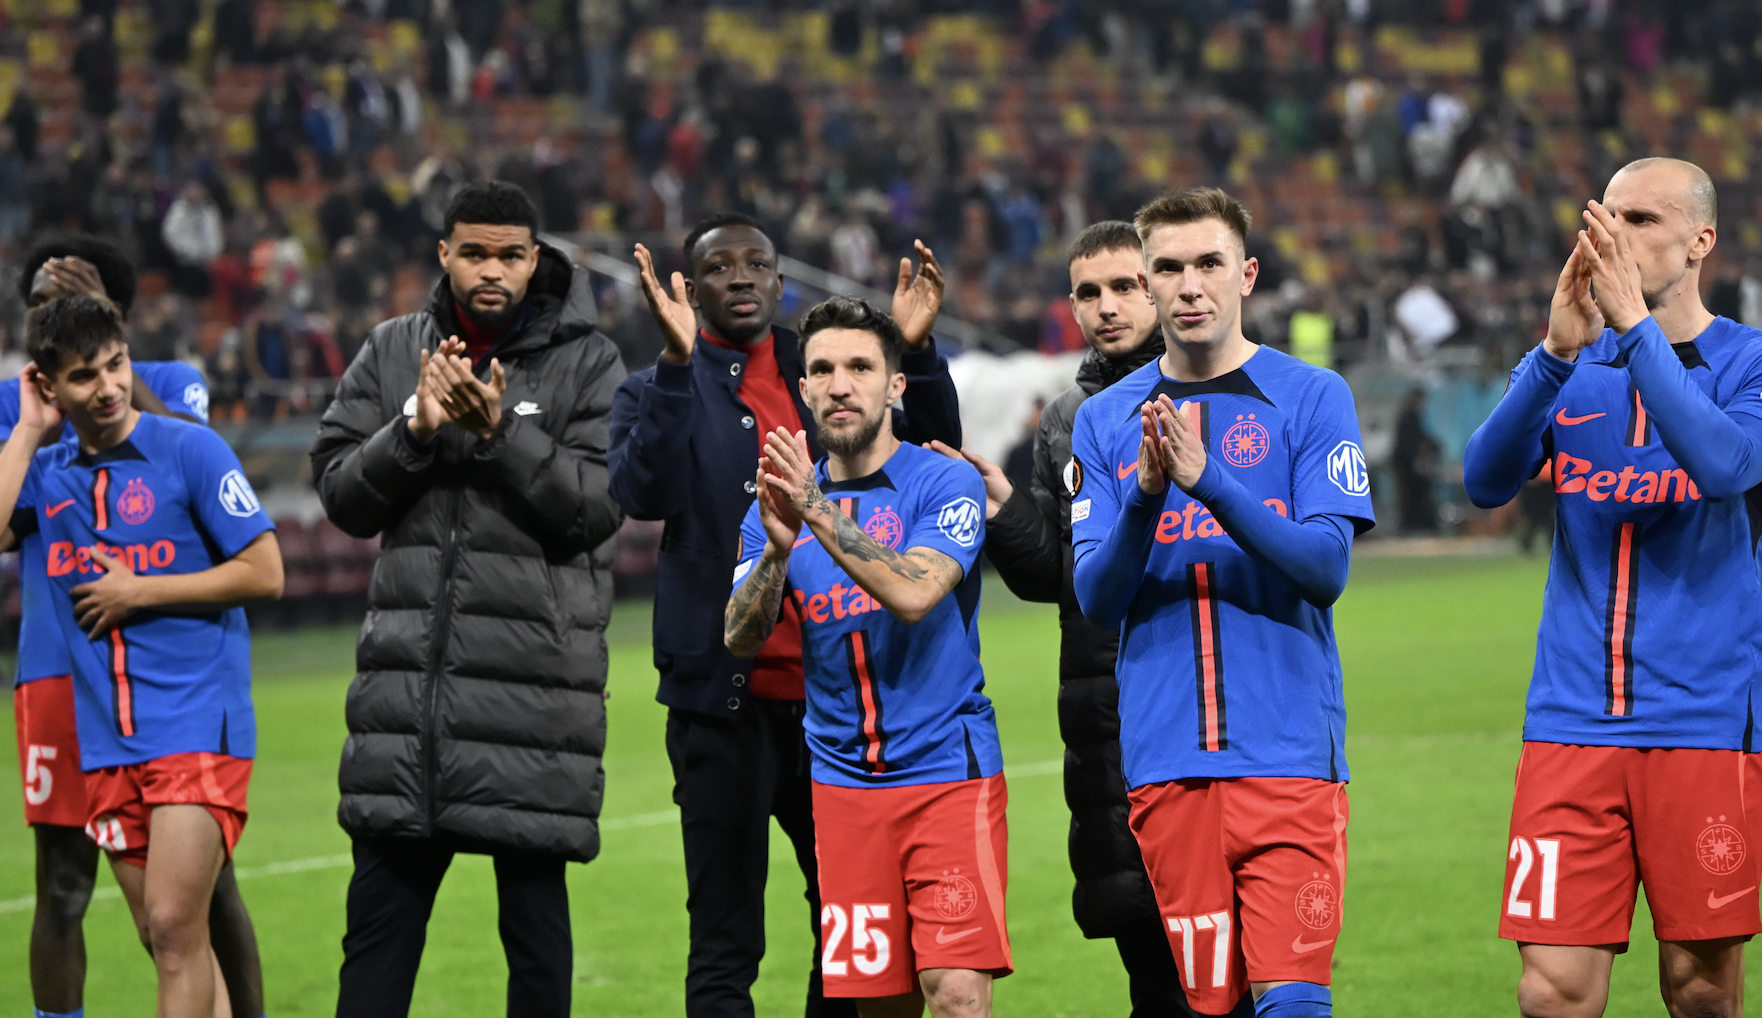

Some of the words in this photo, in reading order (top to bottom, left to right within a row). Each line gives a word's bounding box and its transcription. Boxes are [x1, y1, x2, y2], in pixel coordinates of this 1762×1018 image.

[1332, 445, 1369, 492] MG
[25, 744, 57, 805] 5
[1507, 837, 1560, 920] 21
[820, 902, 890, 976] 25
[1166, 910, 1231, 989] 77
